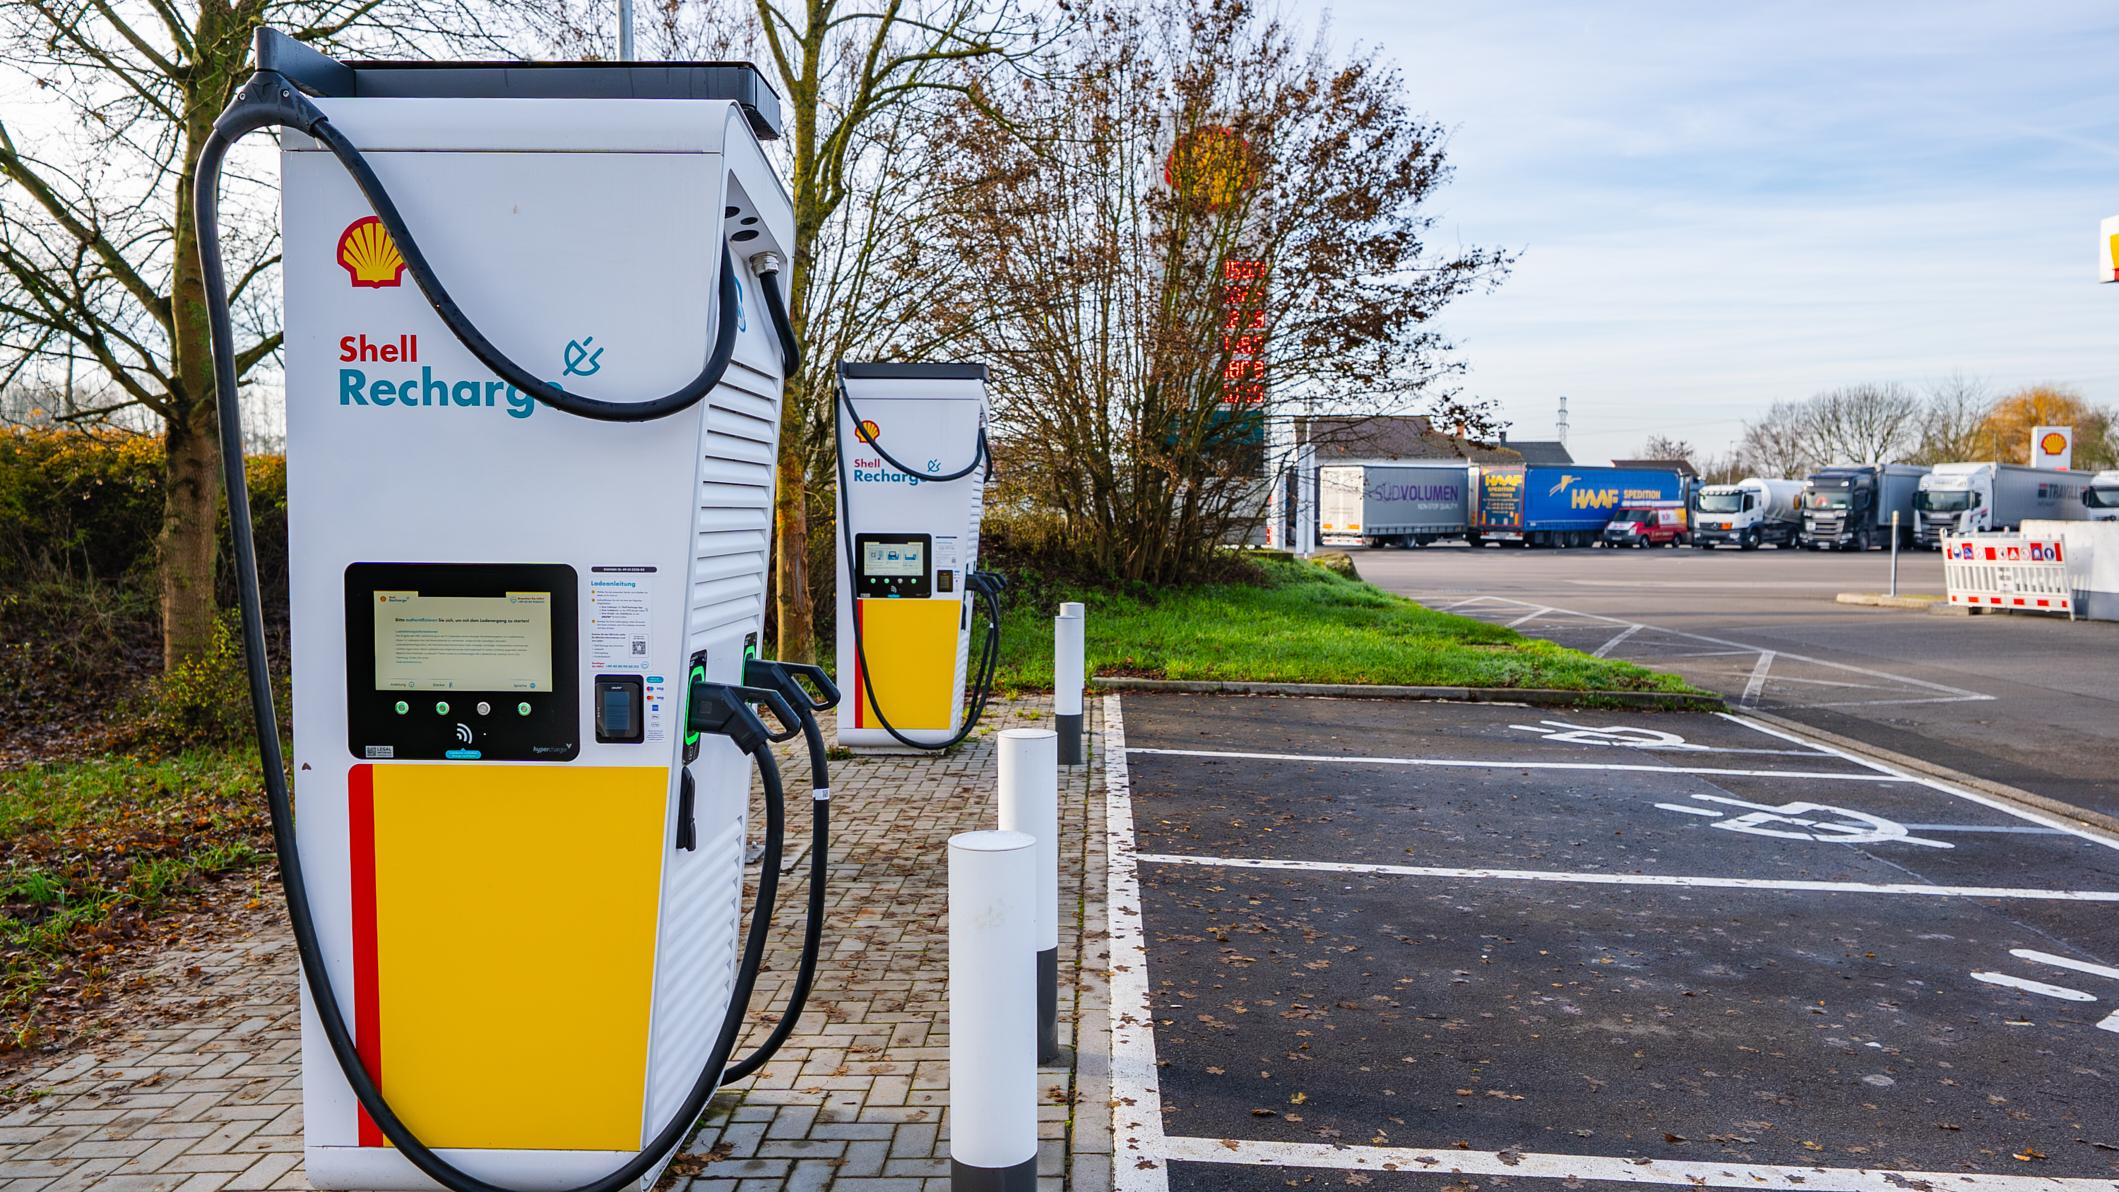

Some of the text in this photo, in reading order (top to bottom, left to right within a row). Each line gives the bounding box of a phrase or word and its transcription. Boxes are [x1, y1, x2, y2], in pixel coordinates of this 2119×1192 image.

[339, 334, 418, 363] Shell
[854, 458, 881, 468] Shell
[1571, 488, 1661, 509] HAAF SPEDITION
[590, 580, 636, 588] Ladeanleitung
